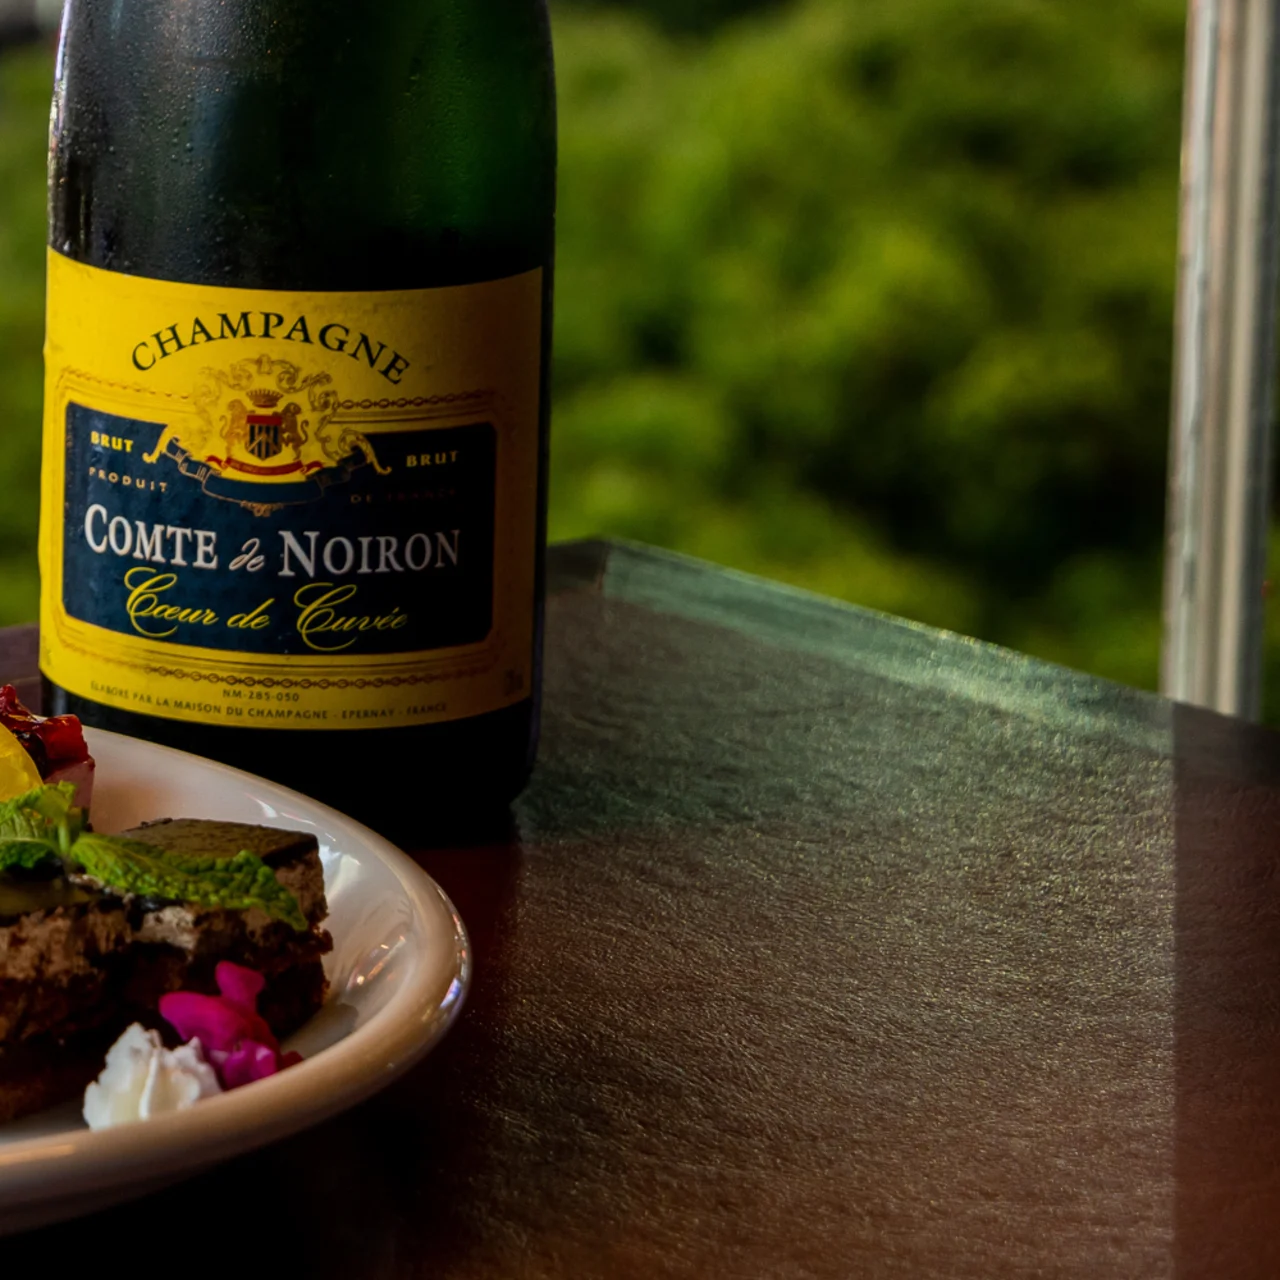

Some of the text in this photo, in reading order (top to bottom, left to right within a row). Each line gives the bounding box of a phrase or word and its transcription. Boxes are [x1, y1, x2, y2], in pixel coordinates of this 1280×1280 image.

[132, 311, 411, 385] CHAMPAGNE
[90, 430, 134, 453] BRUT
[405, 449, 459, 468] BRUT
[88, 466, 168, 493] PRODUIT
[228, 538, 266, 571] de
[278, 529, 460, 578] NOIRON
[226, 597, 275, 630] de
[293, 582, 408, 652] Cuvée
[156, 697, 170, 708] LA
[173, 700, 222, 714] MAISON
[226, 706, 244, 716] DU
[247, 707, 328, 719] CHAMPAGNE
